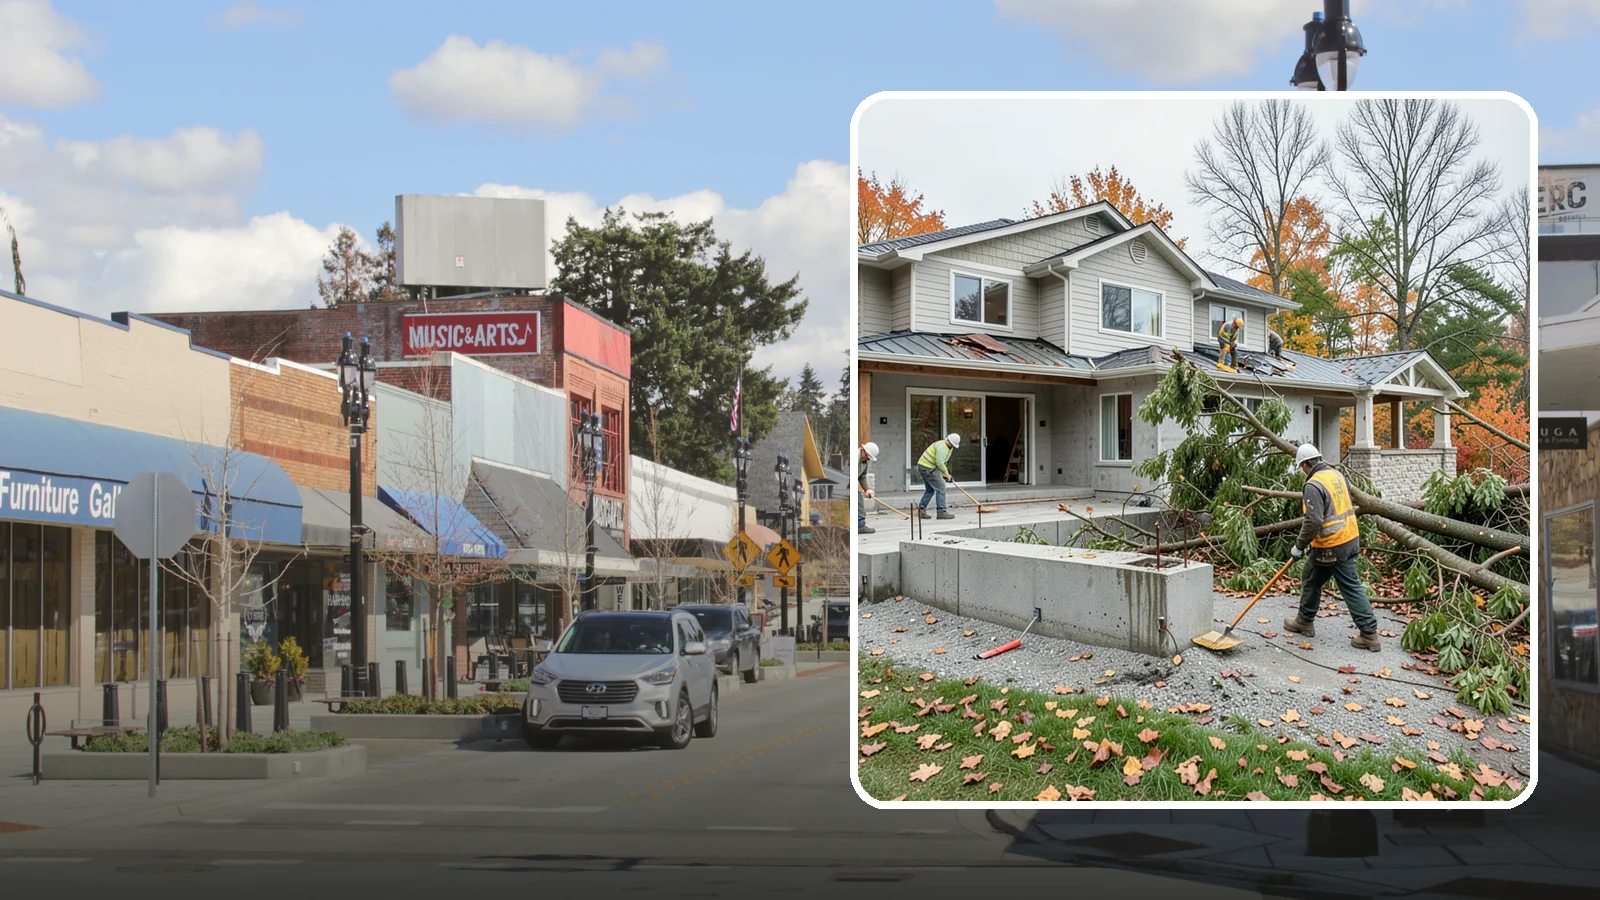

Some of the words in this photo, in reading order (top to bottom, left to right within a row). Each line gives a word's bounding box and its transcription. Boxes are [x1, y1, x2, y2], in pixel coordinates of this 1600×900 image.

[408, 322, 519, 348] MUSIC&ARTS
[0, 471, 79, 515] Furniture
[453, 563, 480, 574] SUSHI
